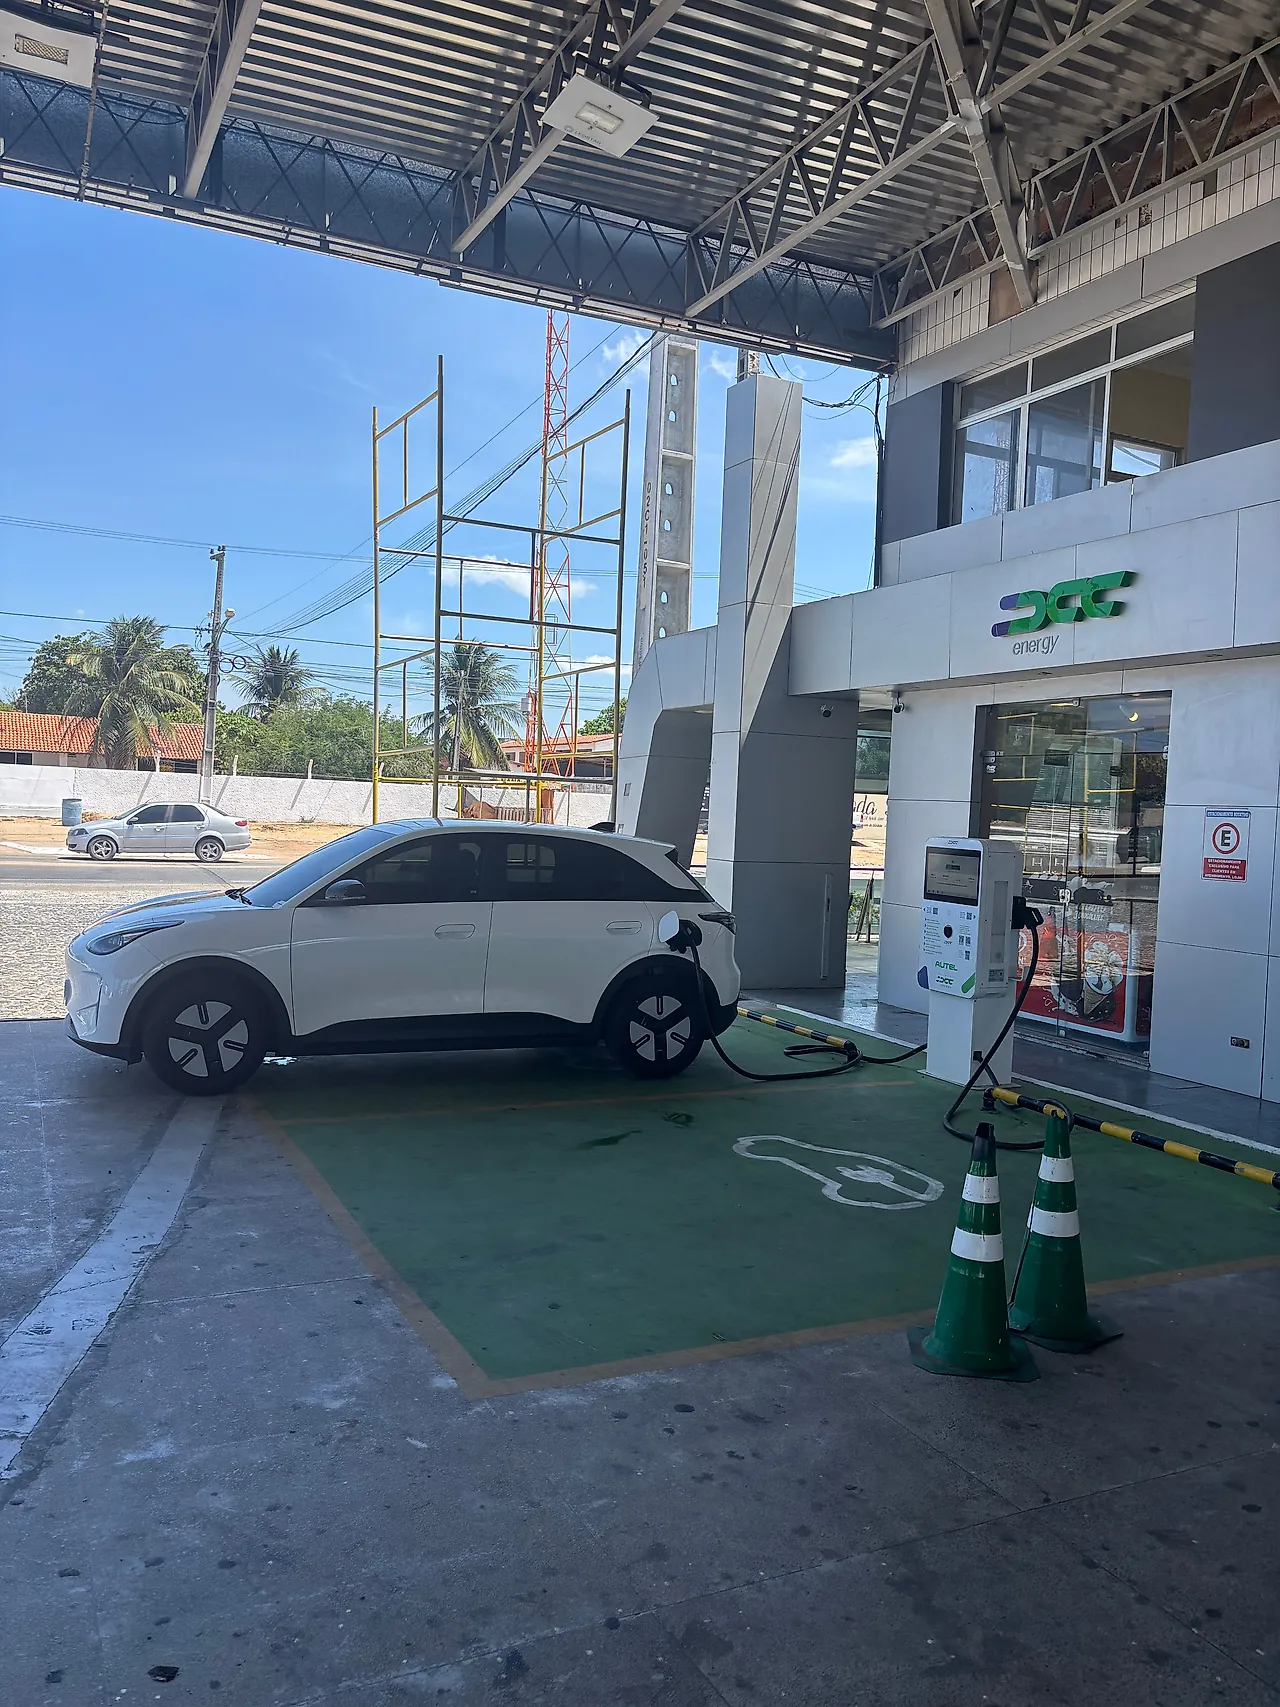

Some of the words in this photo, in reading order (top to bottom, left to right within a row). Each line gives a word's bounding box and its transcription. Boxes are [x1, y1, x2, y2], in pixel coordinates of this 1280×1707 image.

[1012, 635, 1060, 655] energy
[1220, 829, 1231, 846] E
[934, 960, 958, 972] AUTEL
